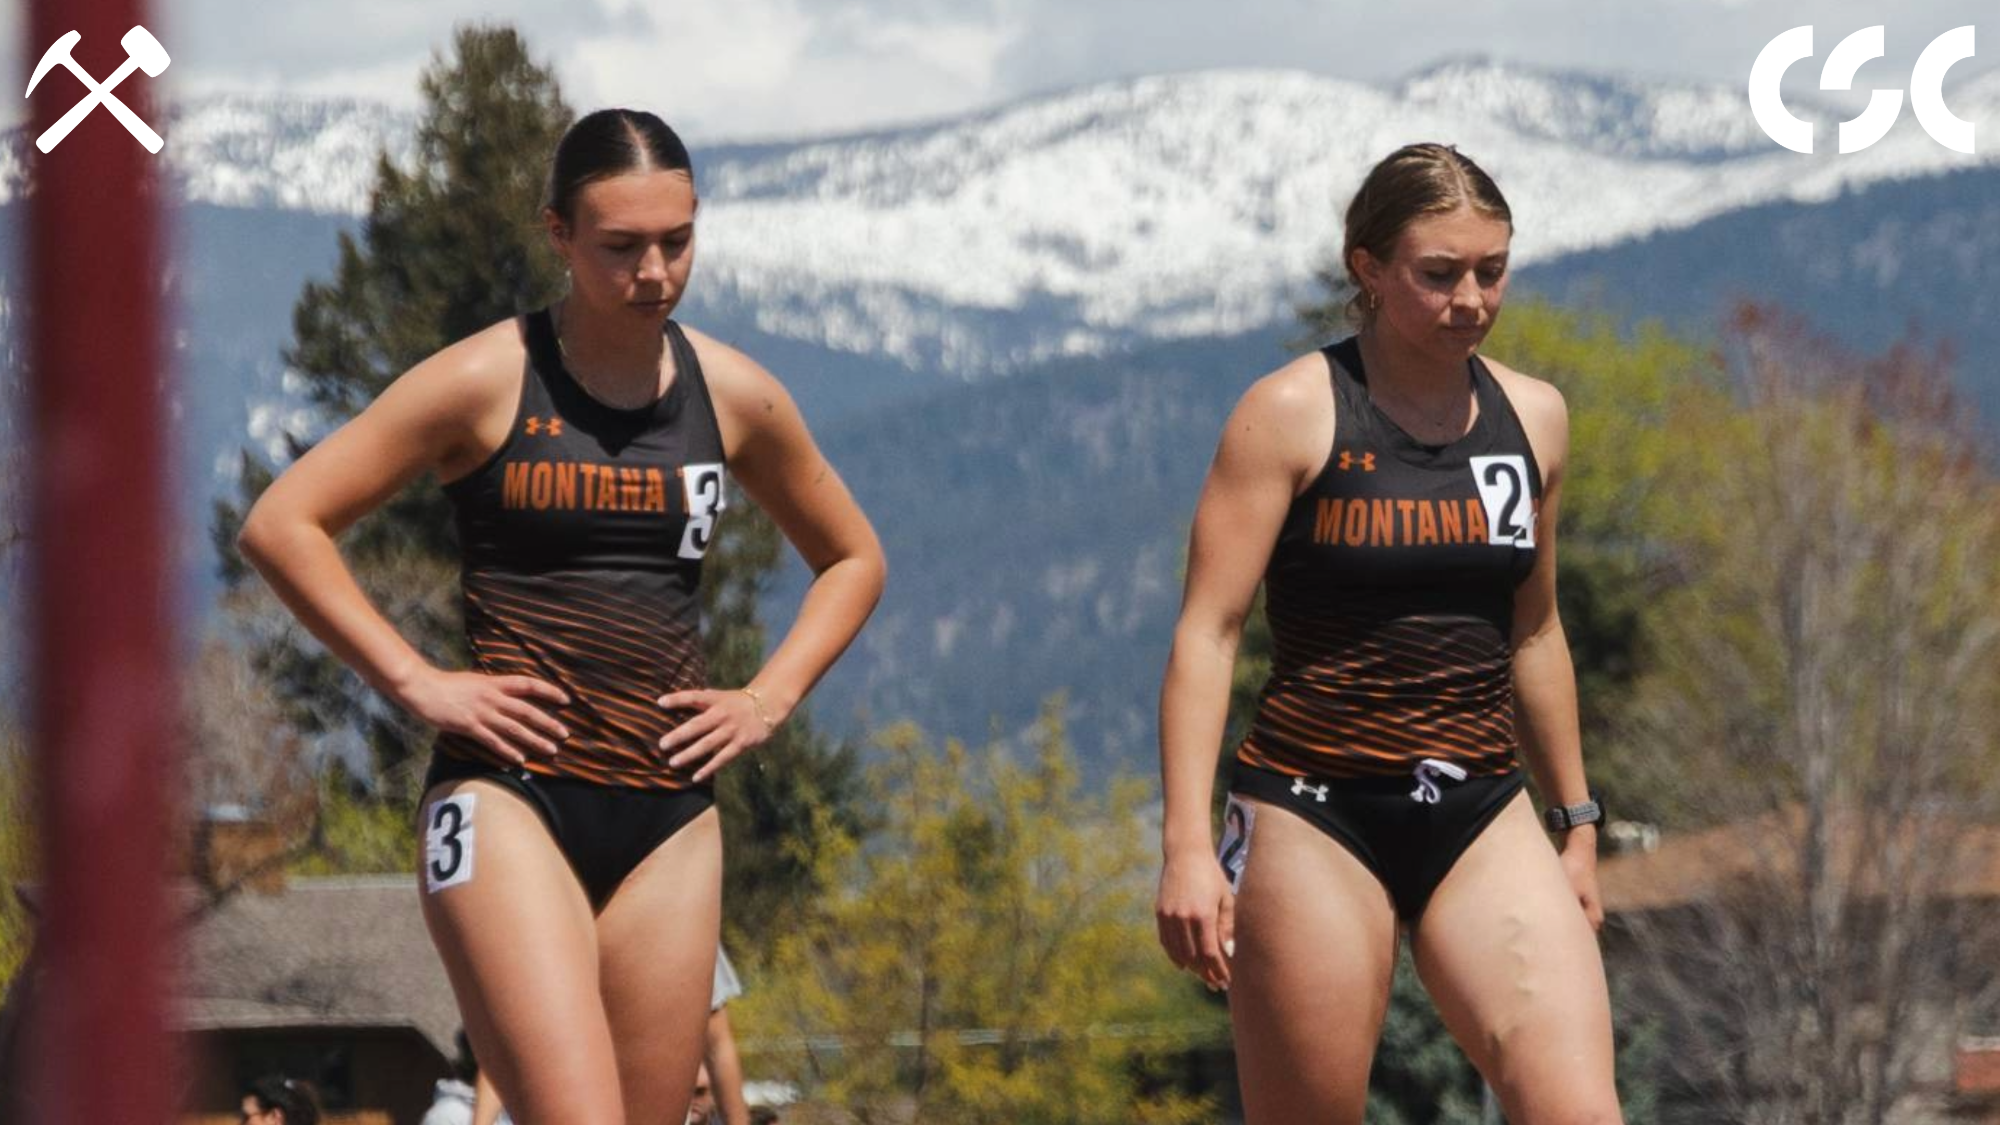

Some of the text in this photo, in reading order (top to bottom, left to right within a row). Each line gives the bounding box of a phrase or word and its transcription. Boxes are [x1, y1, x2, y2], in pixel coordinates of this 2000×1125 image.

[503, 461, 665, 512] MONTANA
[691, 471, 720, 551] 3
[1313, 498, 1488, 547] MONTANA
[1484, 462, 1526, 540] 2
[431, 803, 462, 881] 3
[1220, 803, 1246, 884] 2
